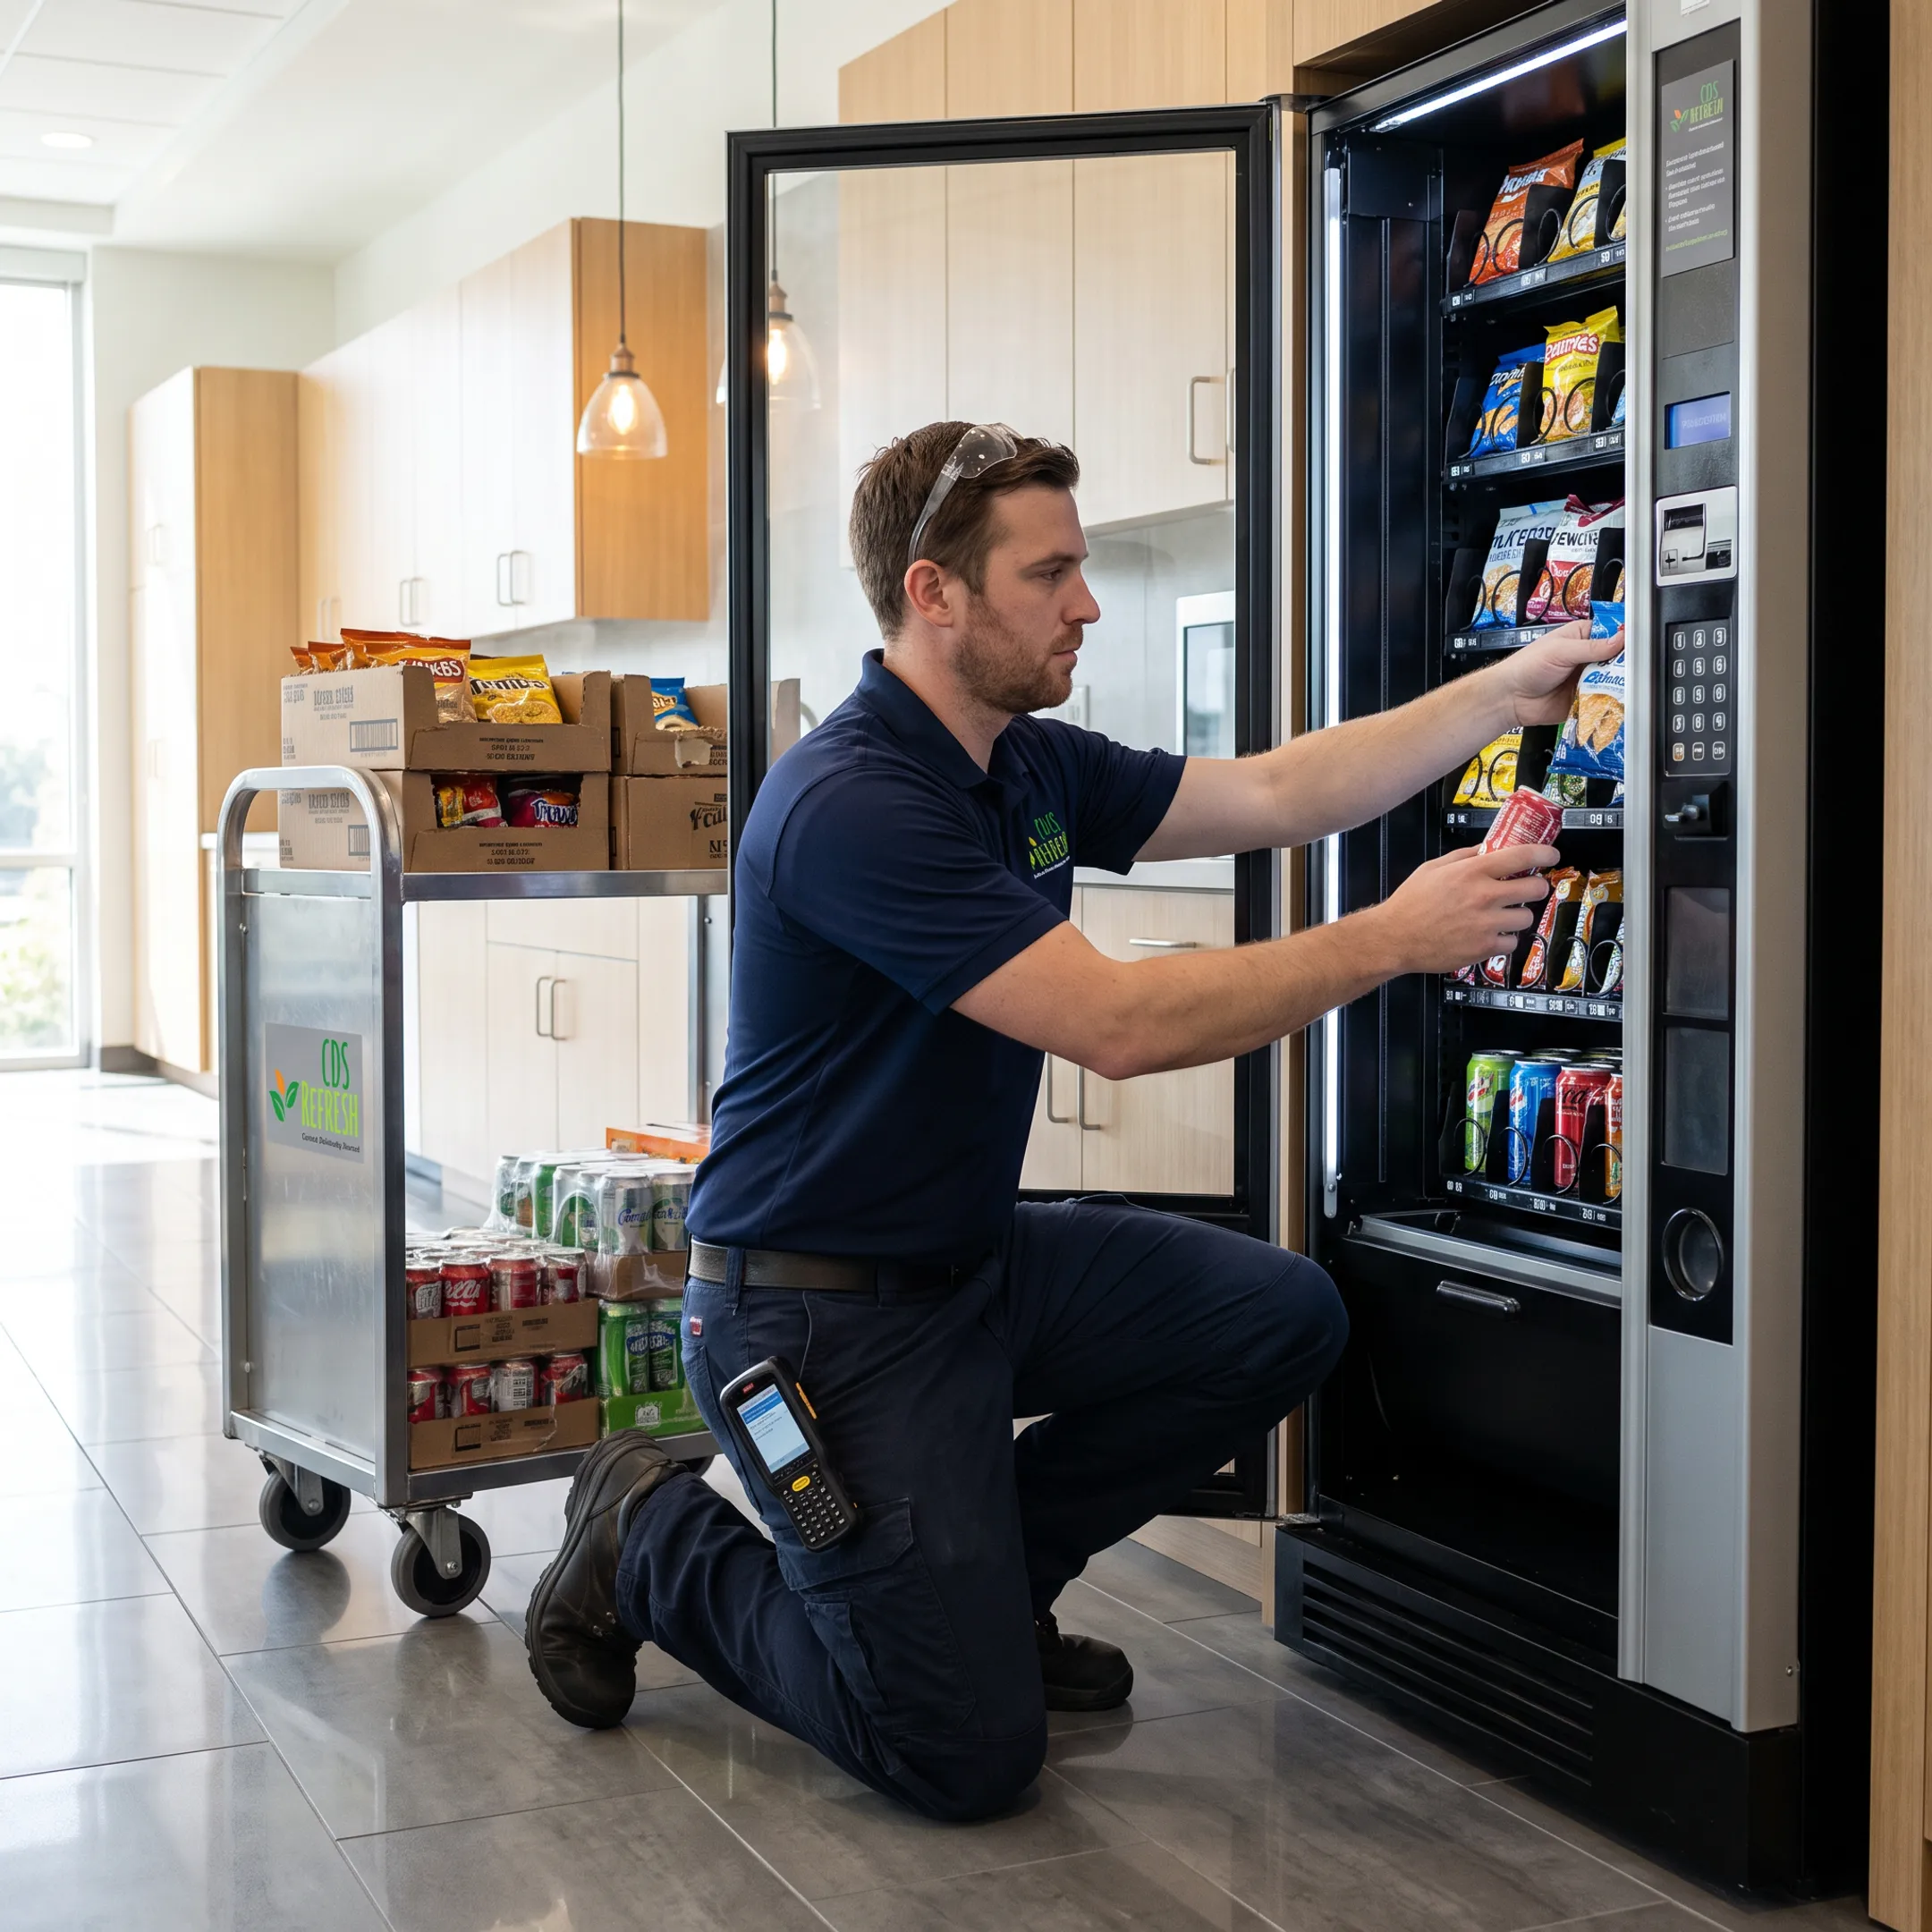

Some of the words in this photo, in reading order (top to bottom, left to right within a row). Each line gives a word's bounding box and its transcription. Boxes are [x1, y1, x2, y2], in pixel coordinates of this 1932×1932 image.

[1700, 80, 1719, 104] CDS
[1716, 630, 1723, 644] 3
[1716, 658, 1723, 672] 6
[321, 1038, 351, 1090] CDS
[301, 1080, 359, 1138] REFRESH
